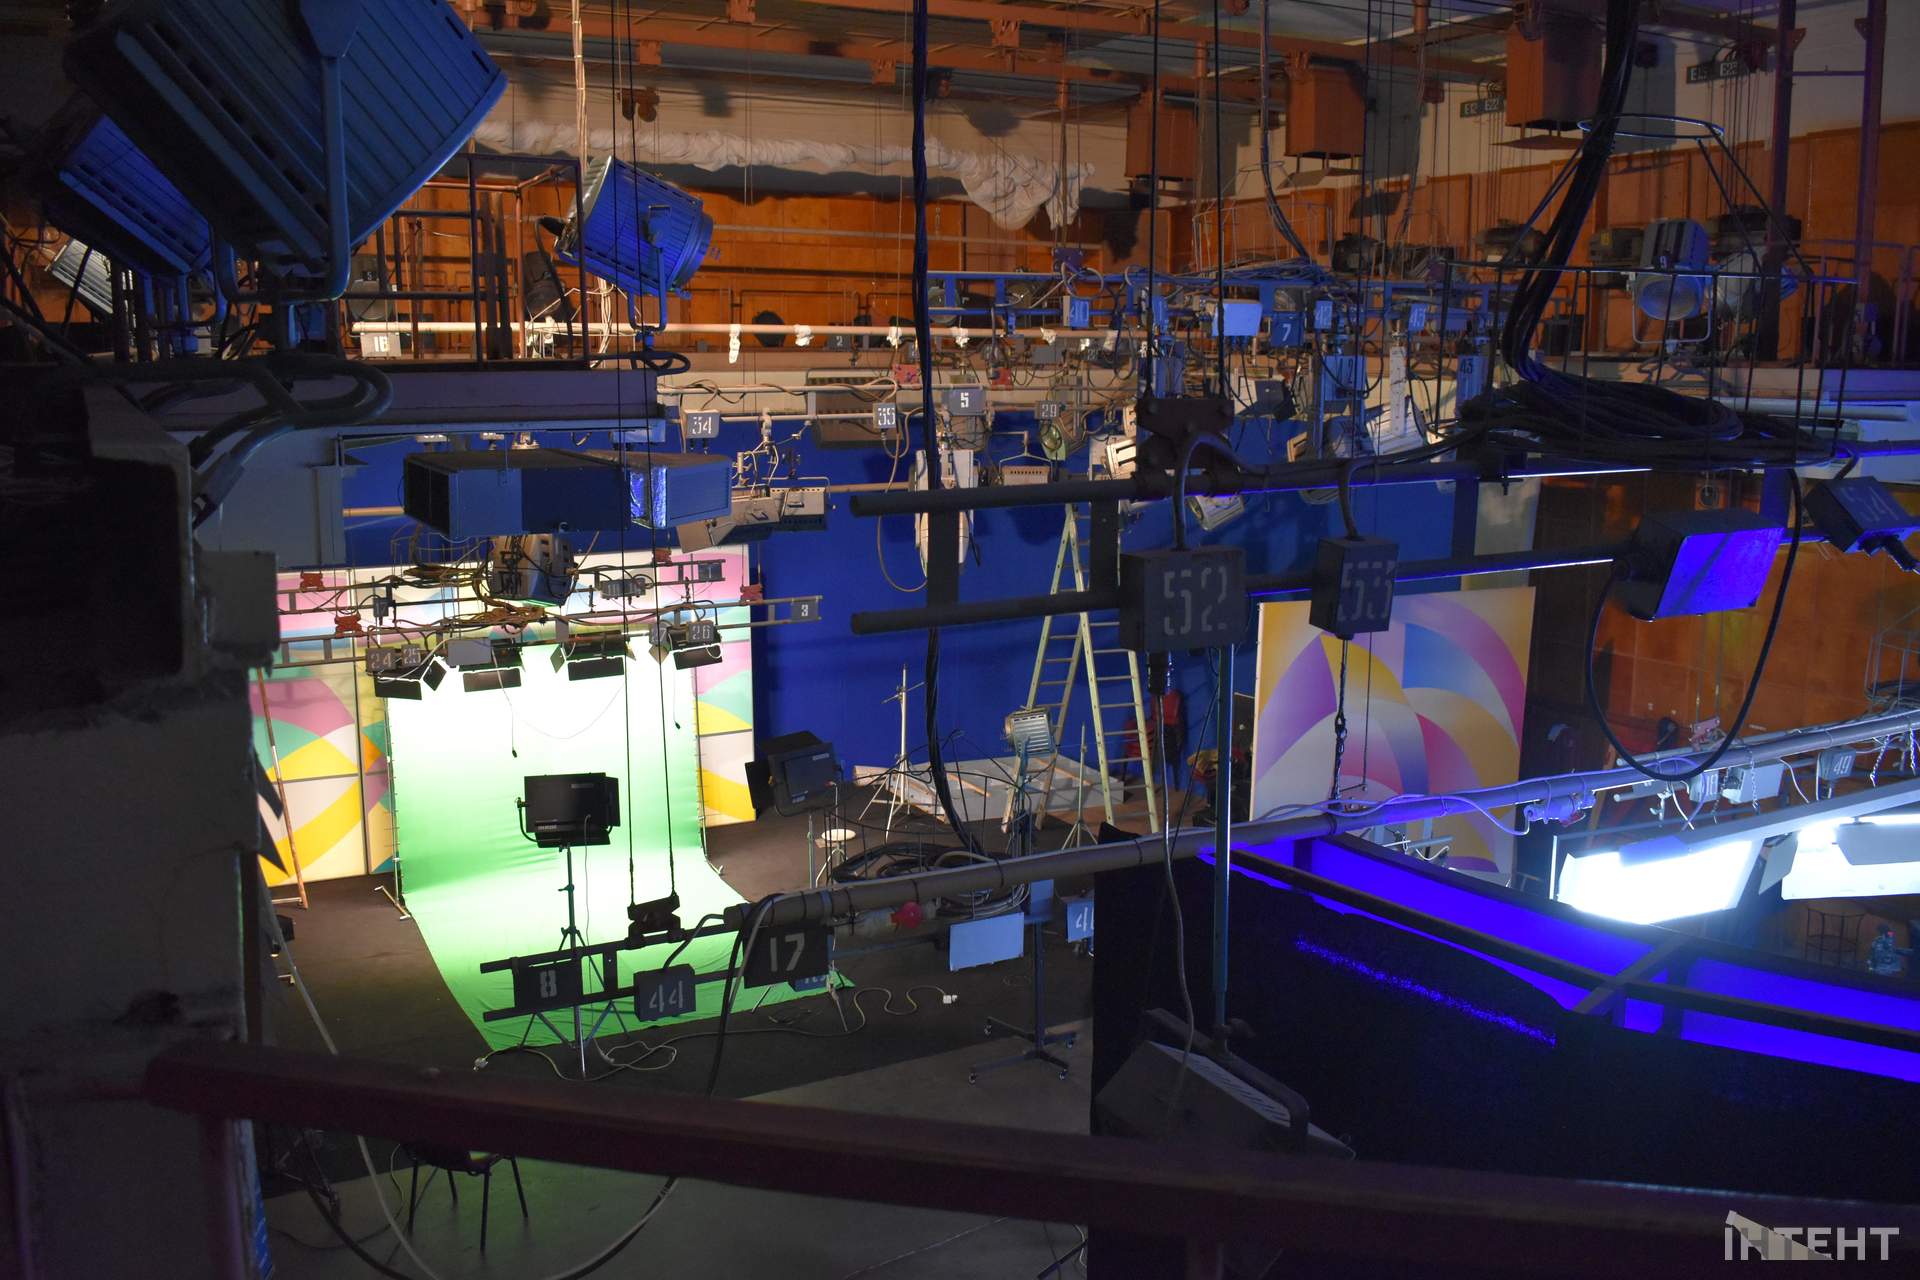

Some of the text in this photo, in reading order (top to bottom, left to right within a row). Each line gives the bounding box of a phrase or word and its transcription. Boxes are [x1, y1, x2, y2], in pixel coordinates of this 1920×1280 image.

[1282, 323, 1292, 342] 7
[960, 392, 968, 408] 5
[691, 416, 712, 435] 34
[801, 603, 809, 617] 3
[1163, 566, 1228, 636] 52
[692, 624, 711, 640] 26
[768, 931, 804, 973] 17
[539, 969, 557, 999] 8
[649, 979, 685, 1013] 44
